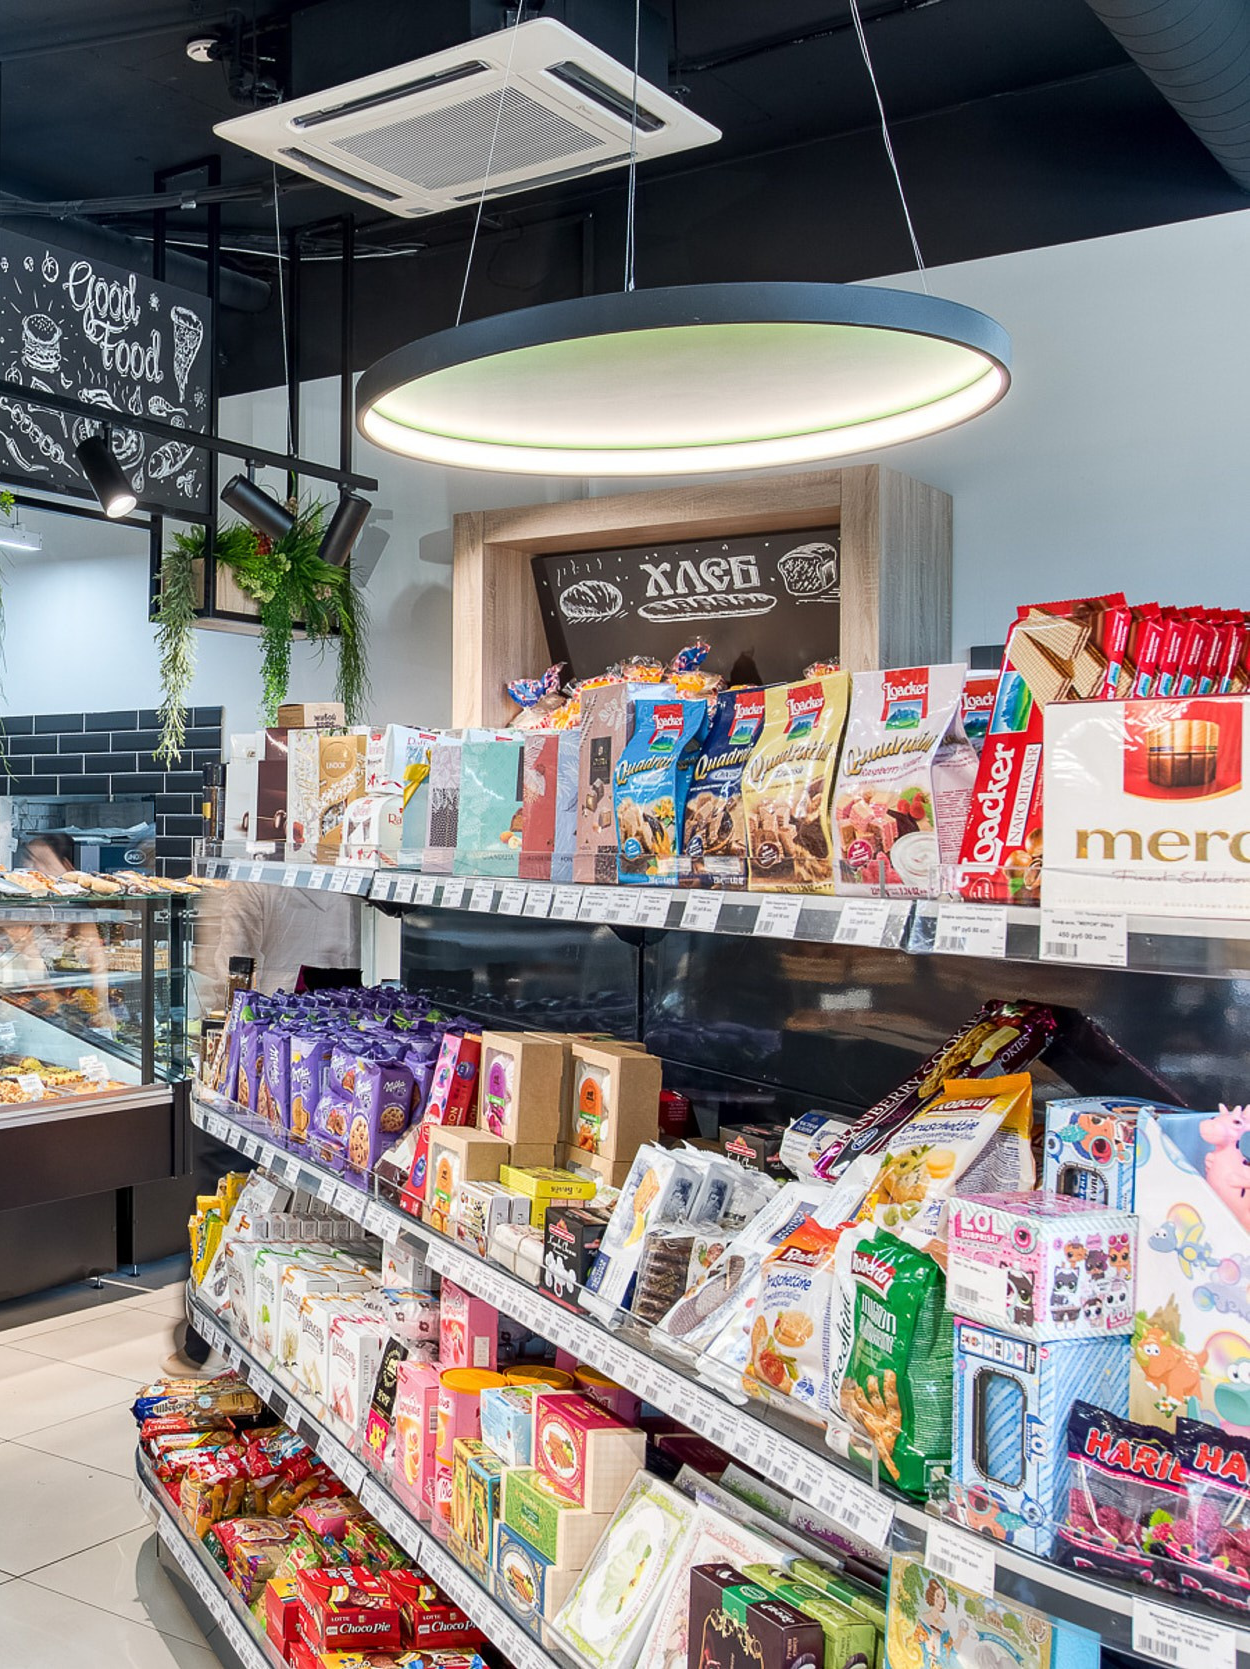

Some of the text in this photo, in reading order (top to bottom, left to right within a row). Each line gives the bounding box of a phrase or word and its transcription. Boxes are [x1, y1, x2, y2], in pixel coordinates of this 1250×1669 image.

[62, 260, 141, 327] Good
[84, 312, 164, 384] Food
[639, 555, 761, 597] ХЛЕБ
[882, 682, 929, 701] Loacker
[735, 703, 765, 719] Loacker
[786, 697, 825, 716] Loacker
[652, 714, 684, 729] Loacker
[1009, 746, 1039, 844] NAPOLITANER
[957, 742, 1016, 888] Loacker
[383, 1080, 406, 1093] Milka
[960, 1209, 1006, 1236] LOL
[960, 1229, 1000, 1244] SURPRISE!
[1109, 1311, 1135, 1324] LOL
[1029, 1423, 1049, 1466] LOL
[422, 1613, 441, 1621] LOTTE
[339, 1621, 391, 1634] Choco Pie
[431, 1621, 465, 1633] Choco
